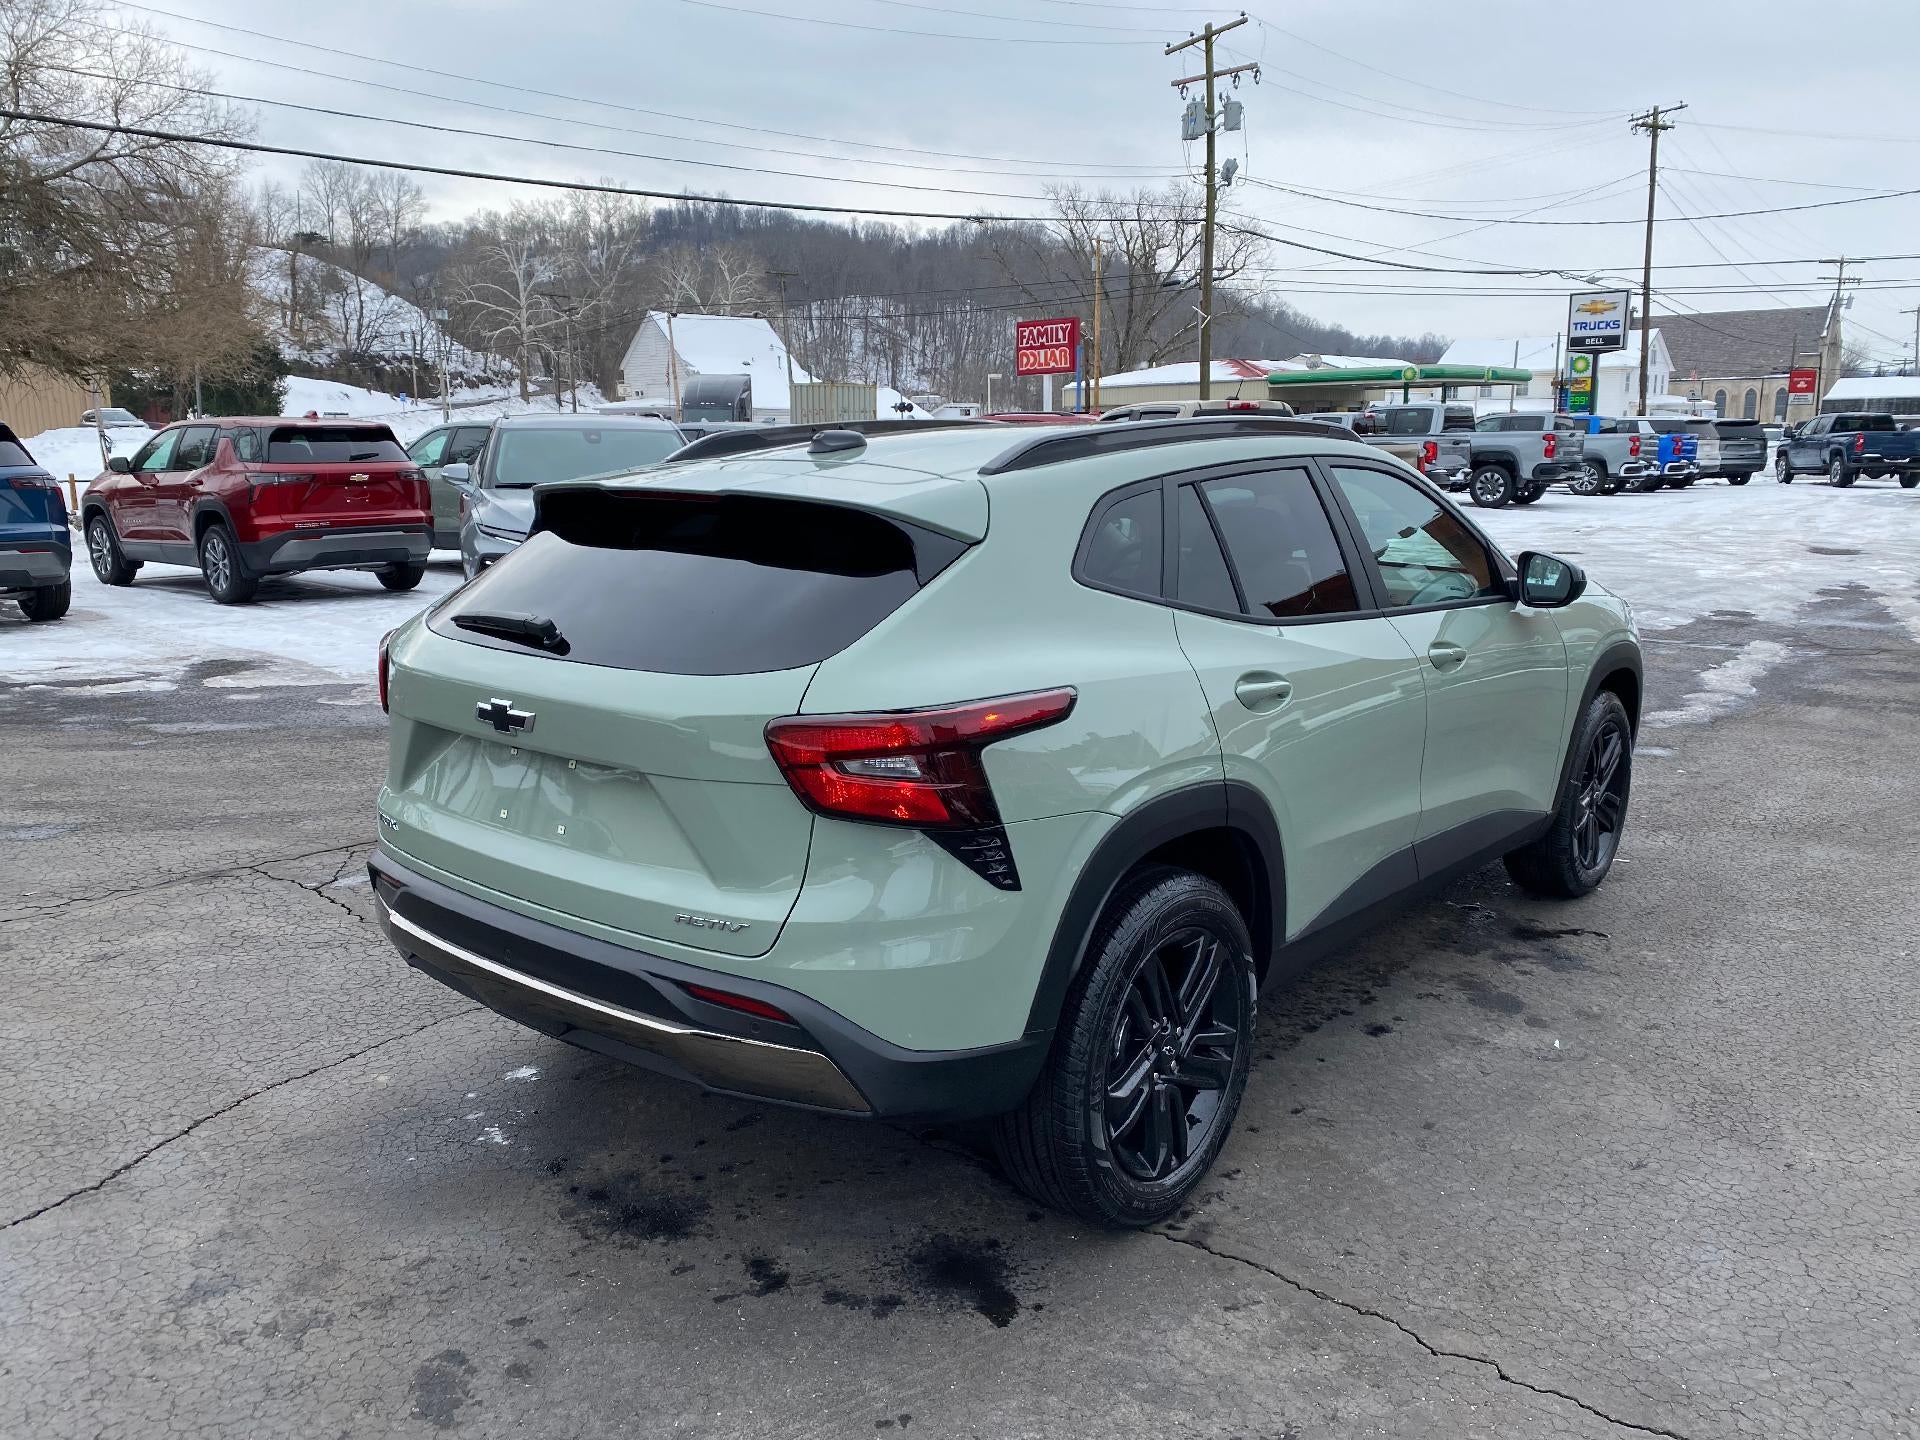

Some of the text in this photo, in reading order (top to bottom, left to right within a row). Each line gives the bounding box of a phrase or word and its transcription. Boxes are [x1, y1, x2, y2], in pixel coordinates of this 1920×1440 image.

[1573, 320, 1621, 331] TRUCKS
[1019, 323, 1071, 347] FAMILY
[1585, 337, 1605, 345] BELL
[1019, 347, 1070, 371] DOLLAR
